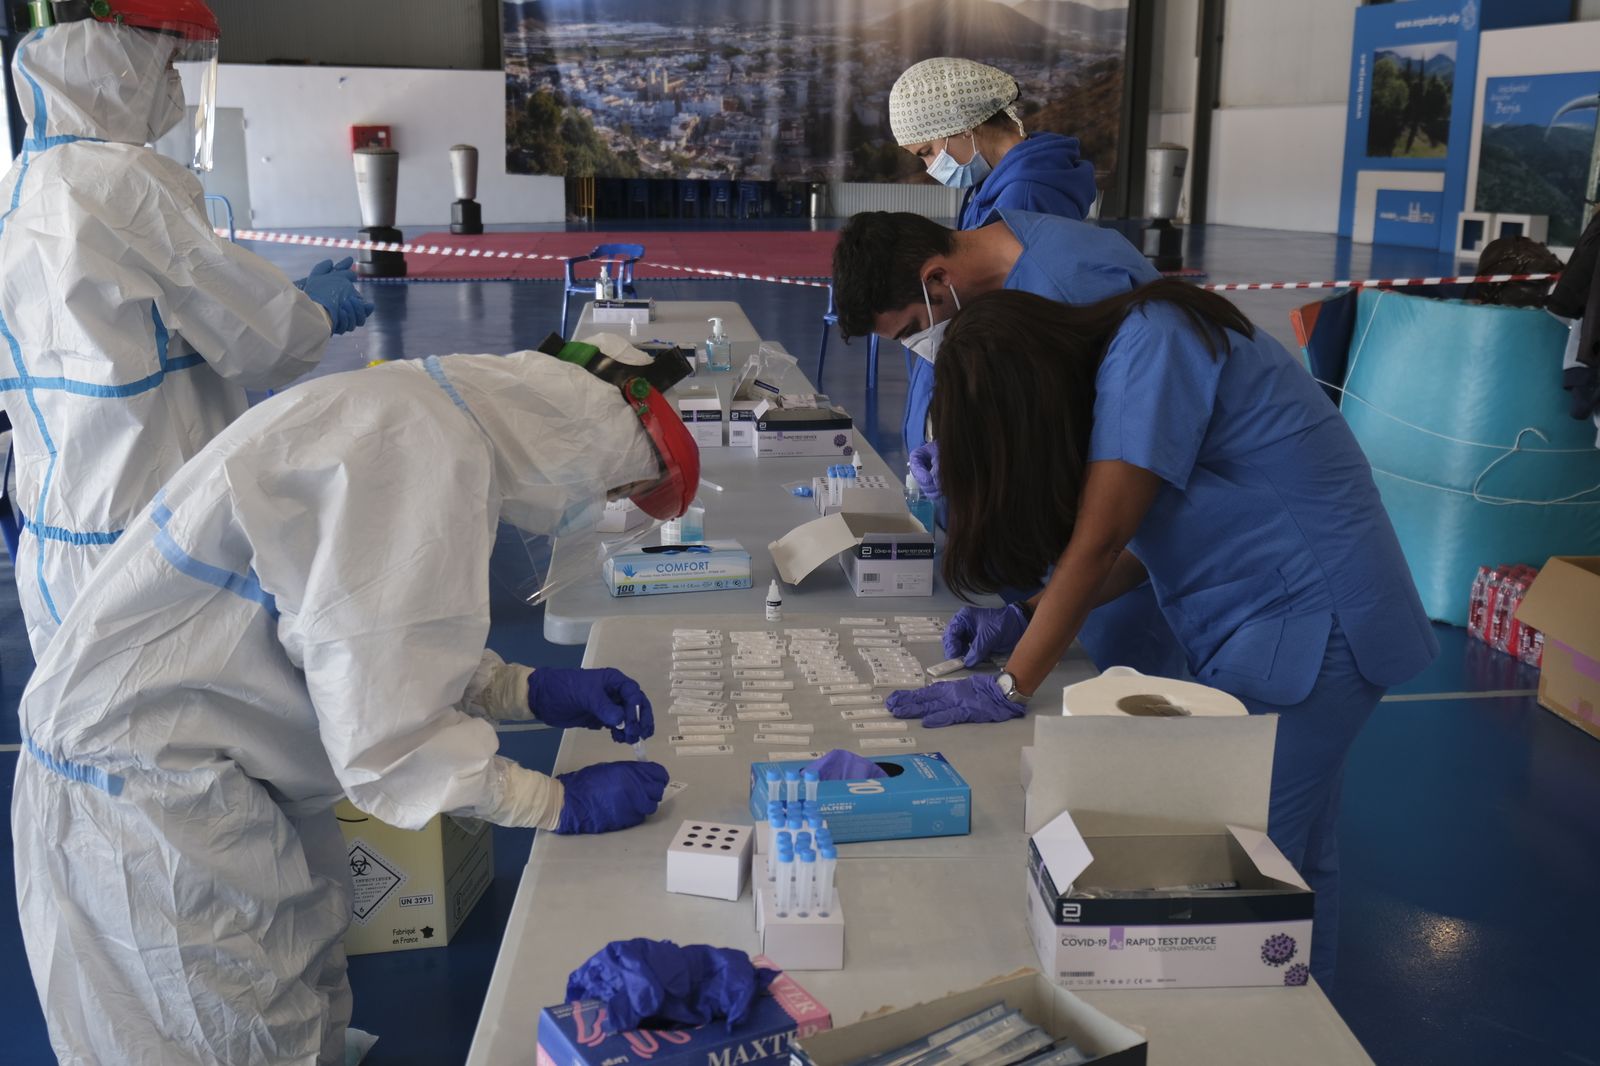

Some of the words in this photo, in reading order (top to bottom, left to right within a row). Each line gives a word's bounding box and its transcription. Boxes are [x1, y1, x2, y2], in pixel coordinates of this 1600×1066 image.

[656, 561, 710, 573] COMFORT
[616, 584, 635, 595] 100
[414, 896, 431, 904] 3291
[1061, 938, 1107, 947] COVID-19
[1126, 938, 1156, 946] RAPID
[1158, 937, 1180, 946] TEST
[1181, 936, 1217, 945] DEVICE
